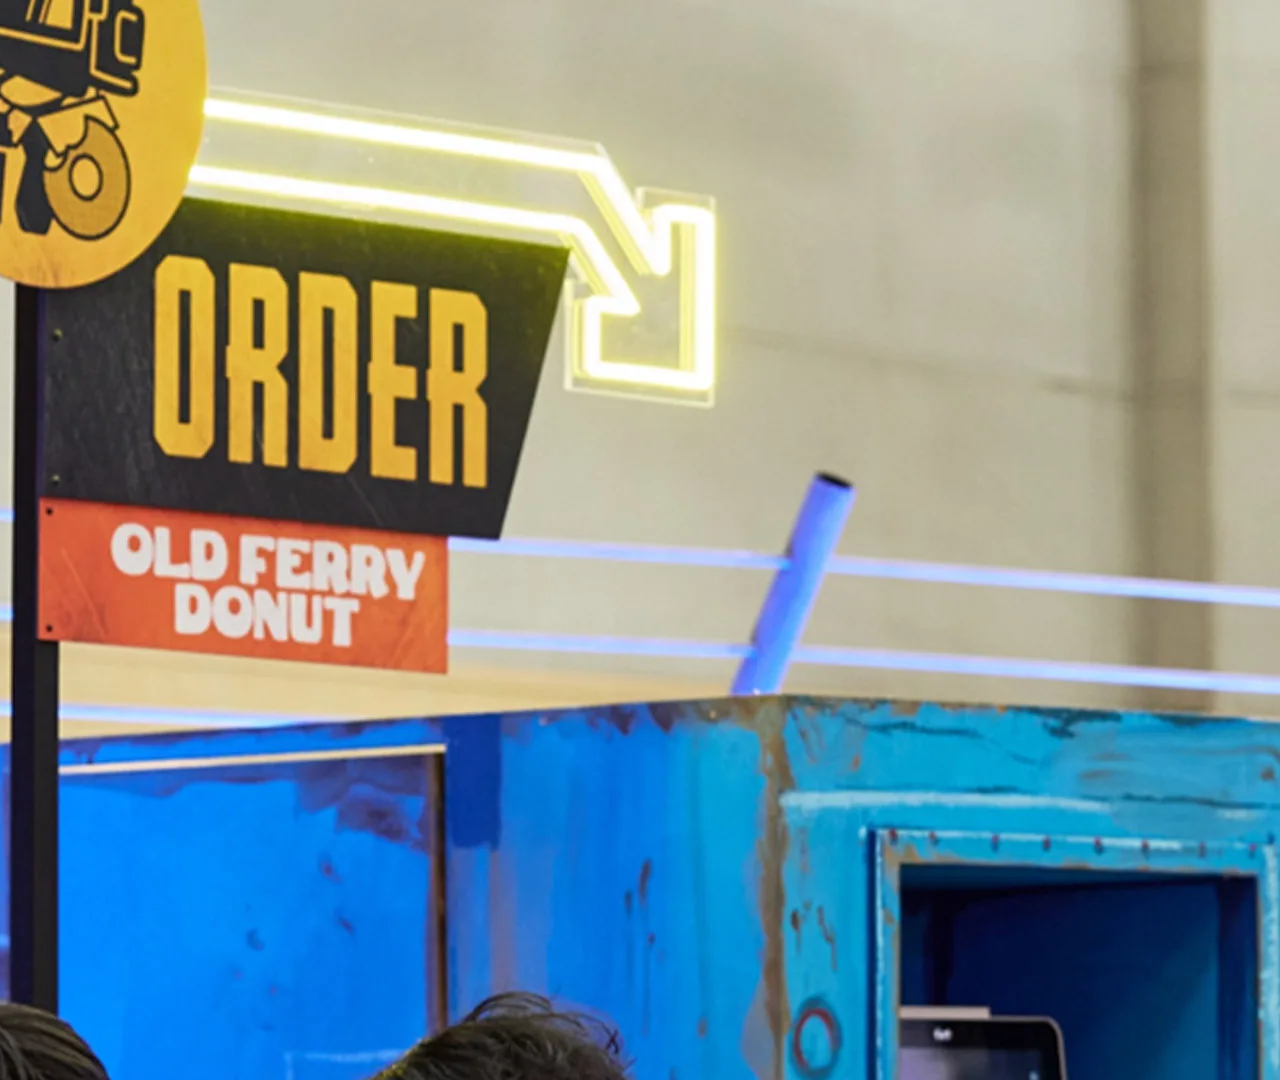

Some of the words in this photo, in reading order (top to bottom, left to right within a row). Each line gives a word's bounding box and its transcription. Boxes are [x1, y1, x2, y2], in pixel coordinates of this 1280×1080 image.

[153, 254, 488, 489] ORDER
[110, 522, 229, 582] OLD
[238, 533, 426, 601] FERRY
[174, 583, 360, 648] DONUT
